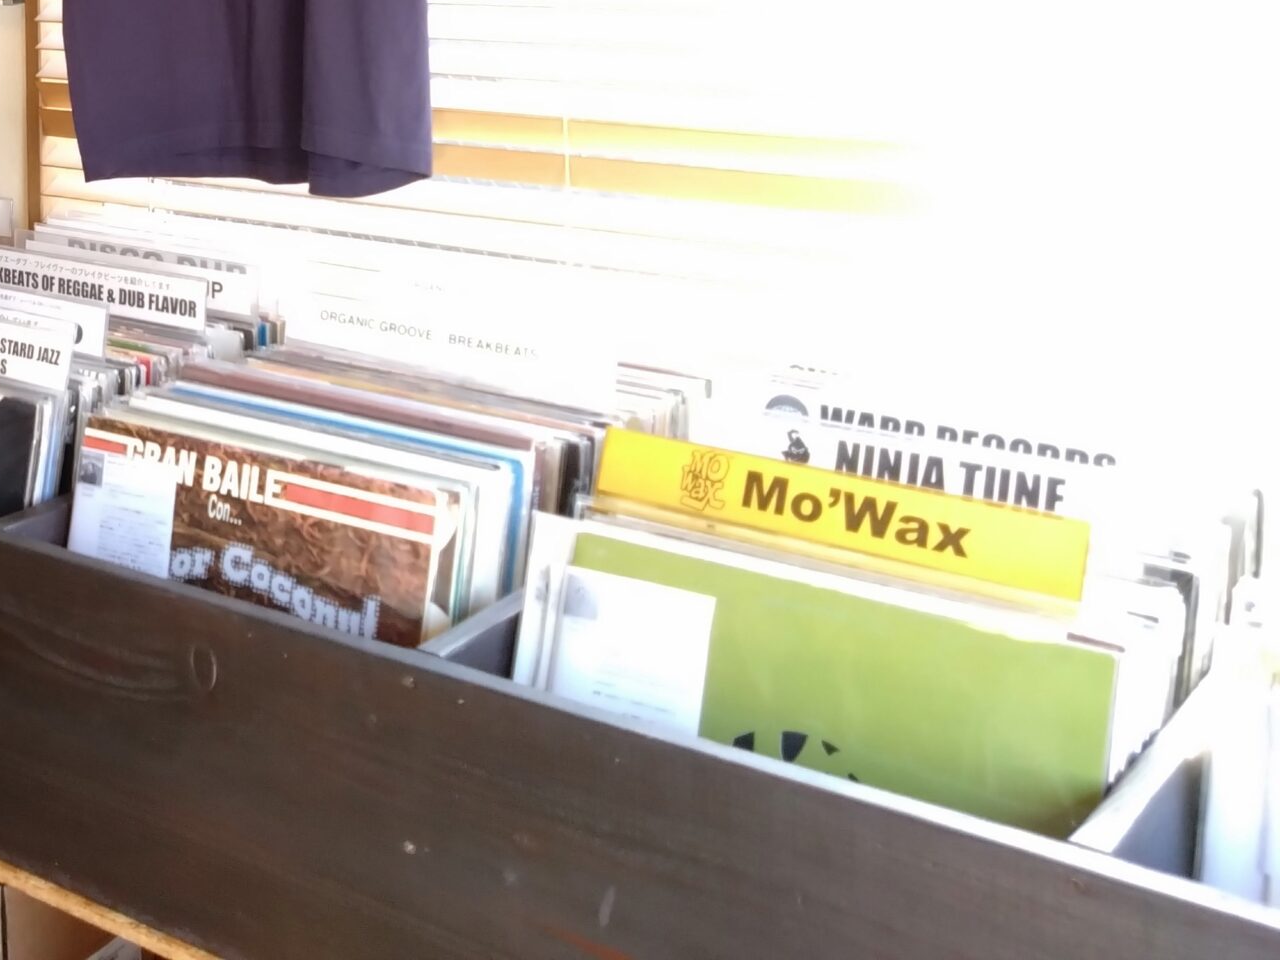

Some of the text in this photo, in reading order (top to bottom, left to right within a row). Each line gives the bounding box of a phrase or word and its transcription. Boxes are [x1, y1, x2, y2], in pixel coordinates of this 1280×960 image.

[41, 276, 56, 293] OF
[57, 277, 104, 302] REGGAE
[106, 288, 116, 305] &
[118, 288, 145, 309] DUB
[148, 294, 197, 319] FLAVOR
[320, 309, 375, 330] ORGANIC
[378, 320, 432, 341] GROOVE
[36, 346, 61, 366] JAZZ
[203, 452, 285, 505] BAILE
[834, 440, 946, 495] NINJA
[207, 494, 243, 526] Con...
[741, 470, 971, 559] Mo'Wax
